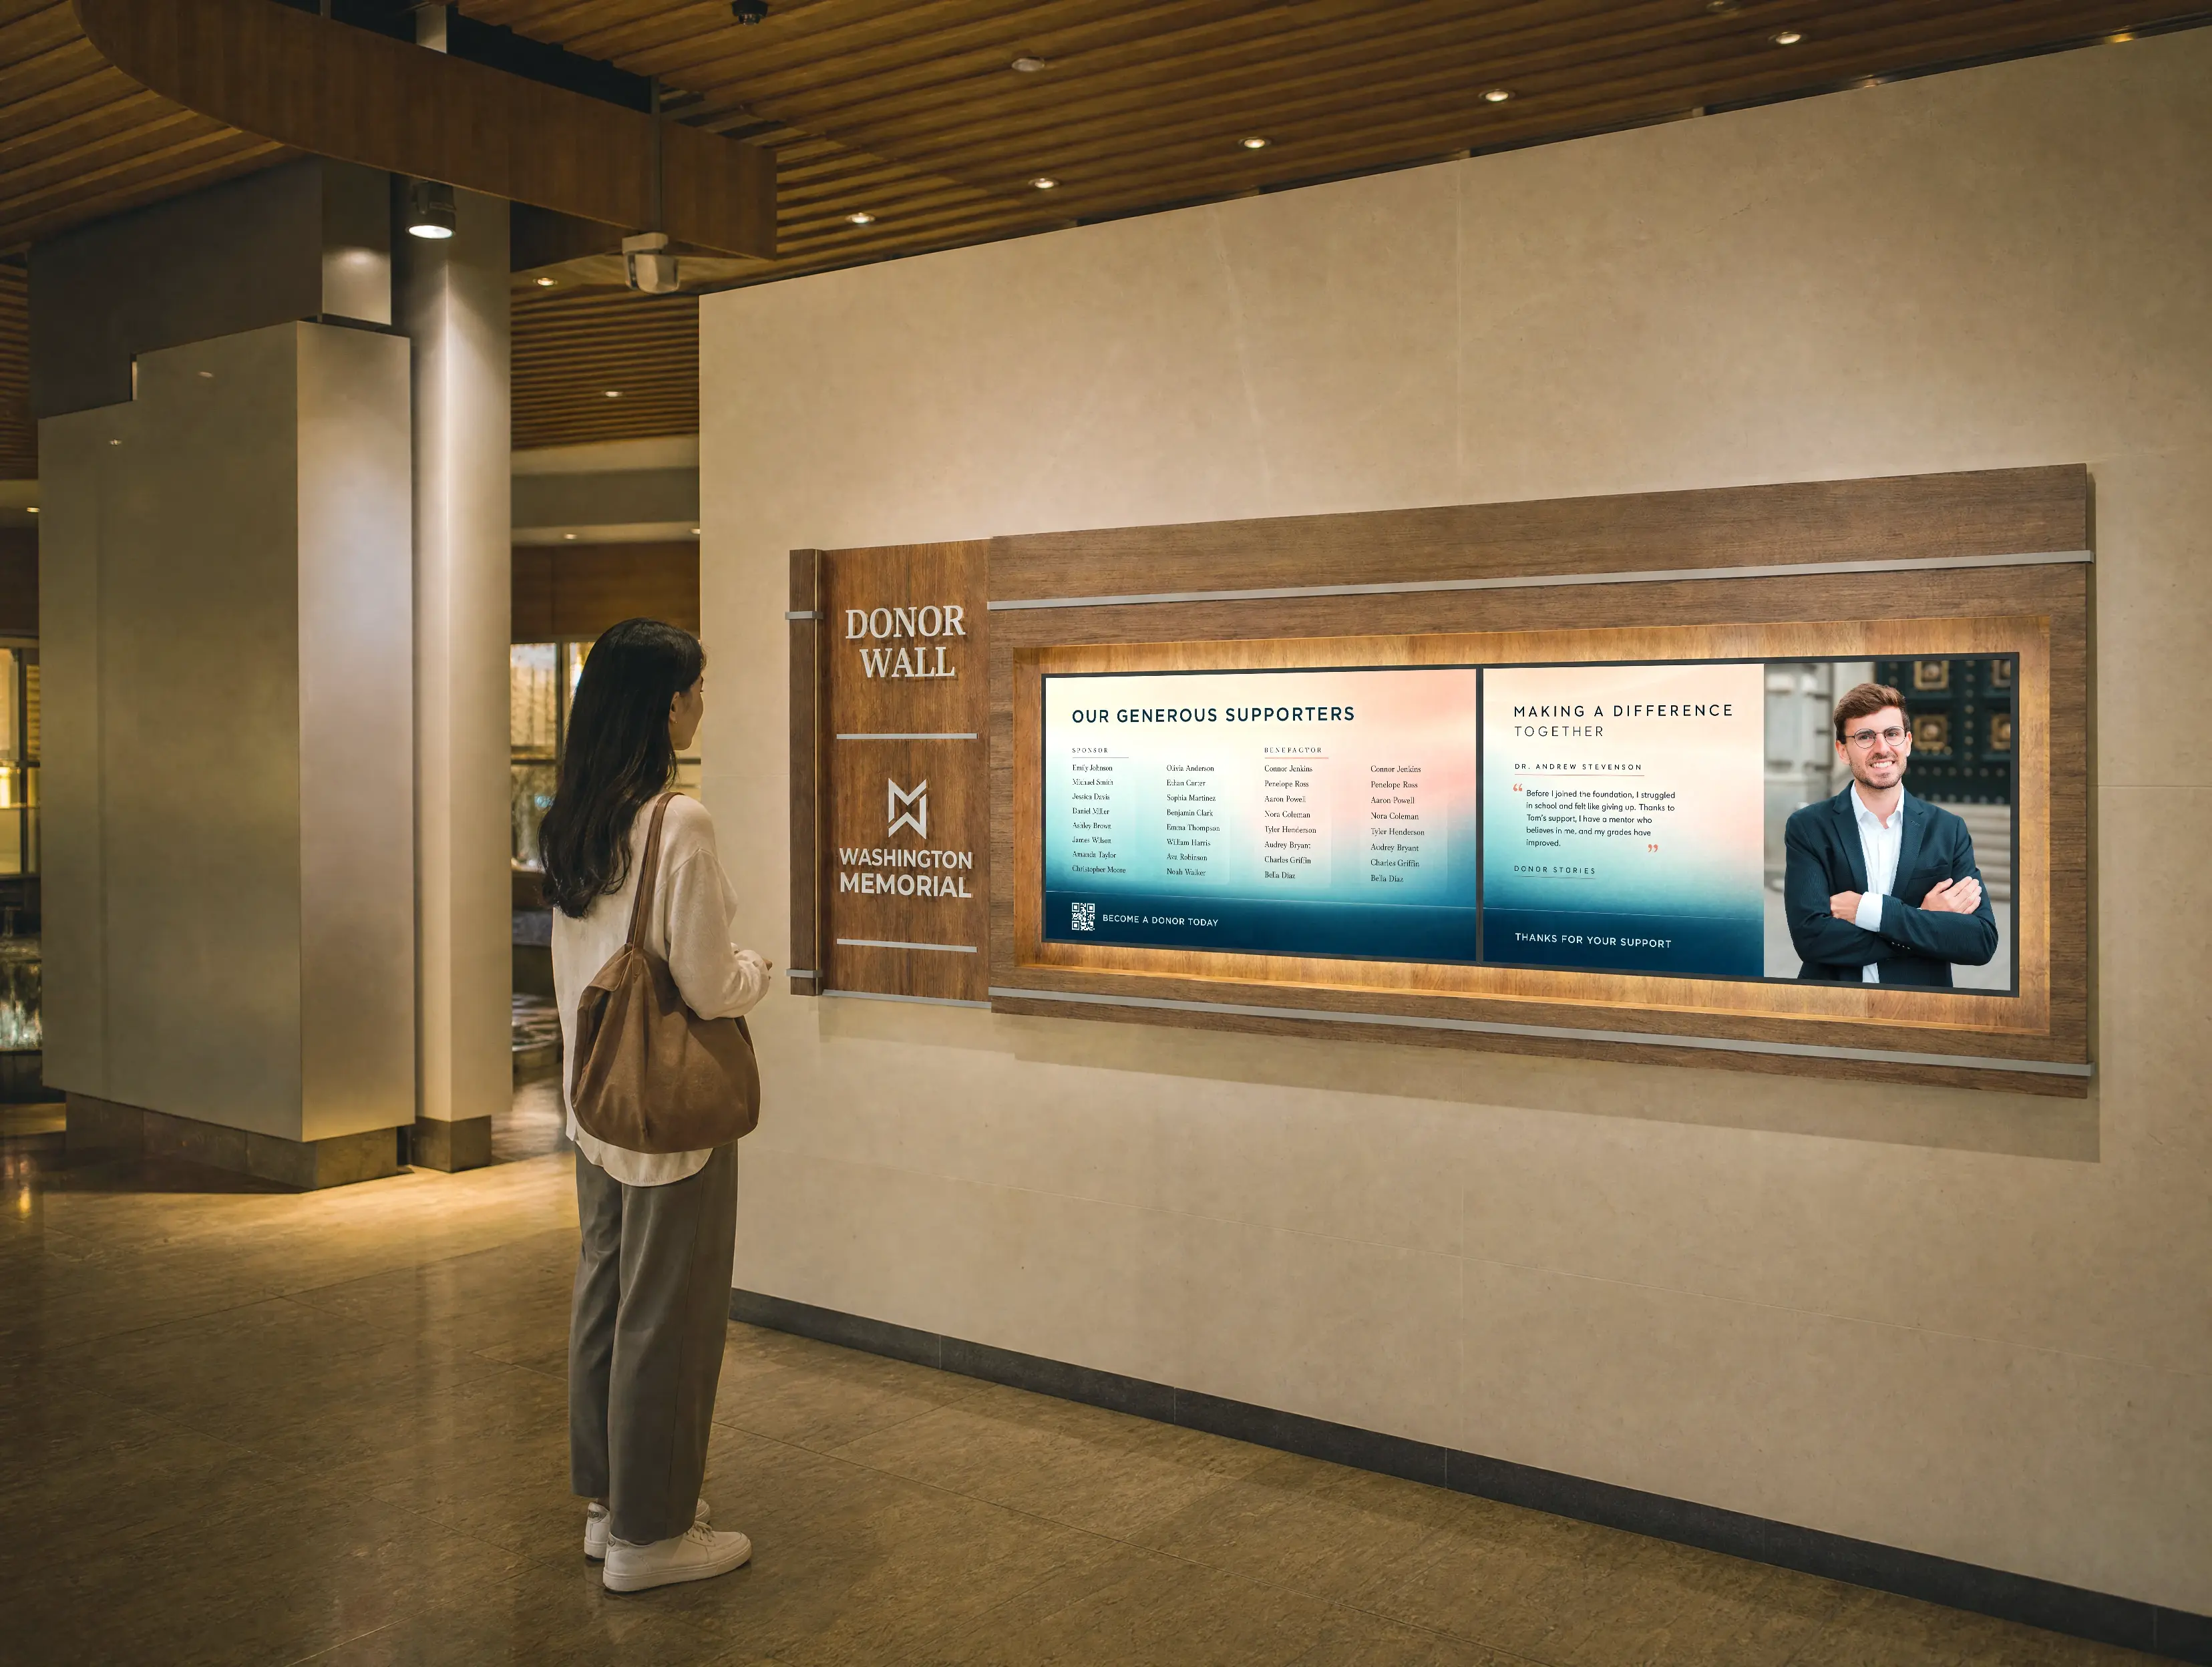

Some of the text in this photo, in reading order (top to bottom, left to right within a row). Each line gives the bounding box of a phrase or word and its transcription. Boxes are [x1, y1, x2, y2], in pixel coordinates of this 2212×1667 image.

[845, 605, 965, 640] DONOR
[860, 646, 955, 678] WALL
[1072, 707, 1354, 723] OUR GENEROUS SUPPORTERS
[1515, 705, 1733, 717] MAKING A DIFFERENCE
[1515, 726, 1604, 737] TOGETHER
[1265, 781, 1293, 789] Penelope
[1371, 781, 1401, 790] Penelope
[1167, 794, 1187, 802] Sophia
[1555, 791, 1577, 799] joined
[1593, 791, 1634, 799] foundation,
[1641, 791, 1676, 800] struggled
[1602, 803, 1623, 812] giving
[1548, 815, 1577, 823] support,
[1073, 822, 1091, 830] Ashley
[1187, 824, 1220, 832] Thompson
[1265, 826, 1280, 835] Tyler
[1371, 828, 1387, 836] Tyler
[1607, 828, 1632, 837] grades
[1265, 842, 1310, 850] Audrey Bryant
[1371, 844, 1419, 853] Audrey Bryant
[1527, 840, 1561, 848] improved.
[839, 848, 972, 870] WASHINGTON
[1099, 852, 1116, 860] Taylor
[1073, 866, 1105, 874] Christopher
[840, 872, 972, 898] MEMORIAL
[1103, 914, 1218, 927] BECOME A DONOR TODAY
[1515, 933, 1672, 948] THANKS FOR YOUR SUPPORT
